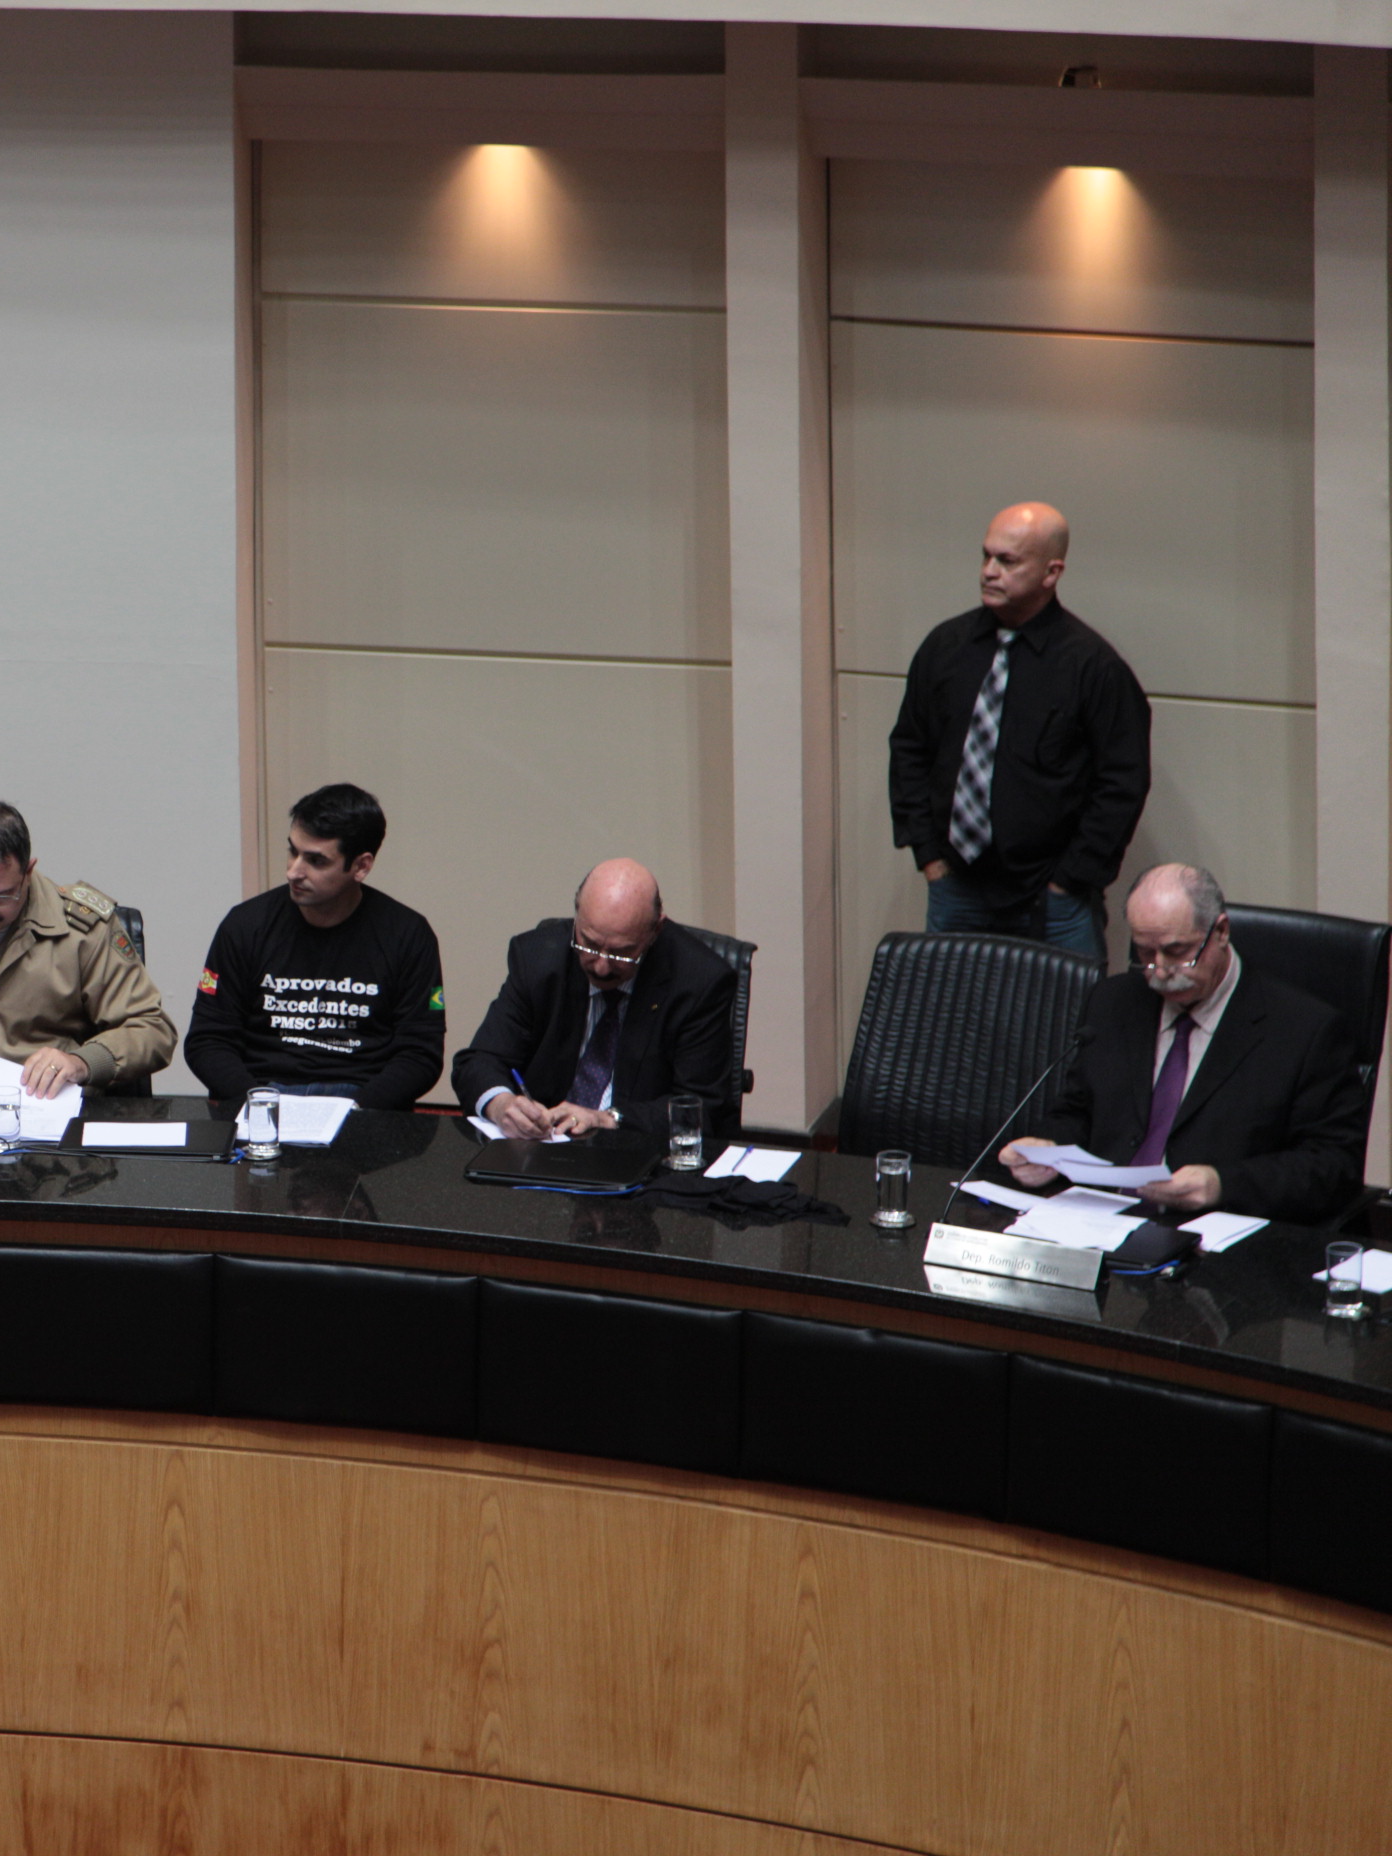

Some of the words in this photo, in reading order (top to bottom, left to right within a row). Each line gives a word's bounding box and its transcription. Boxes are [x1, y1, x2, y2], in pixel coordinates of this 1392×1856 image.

[260, 973, 379, 996] Aprovados
[262, 994, 370, 1018] Excedentes
[270, 1015, 315, 1031] PMSC
[961, 1250, 985, 1265] Dep.
[988, 1254, 1031, 1271] Romildo
[1034, 1262, 1060, 1276] Titon
